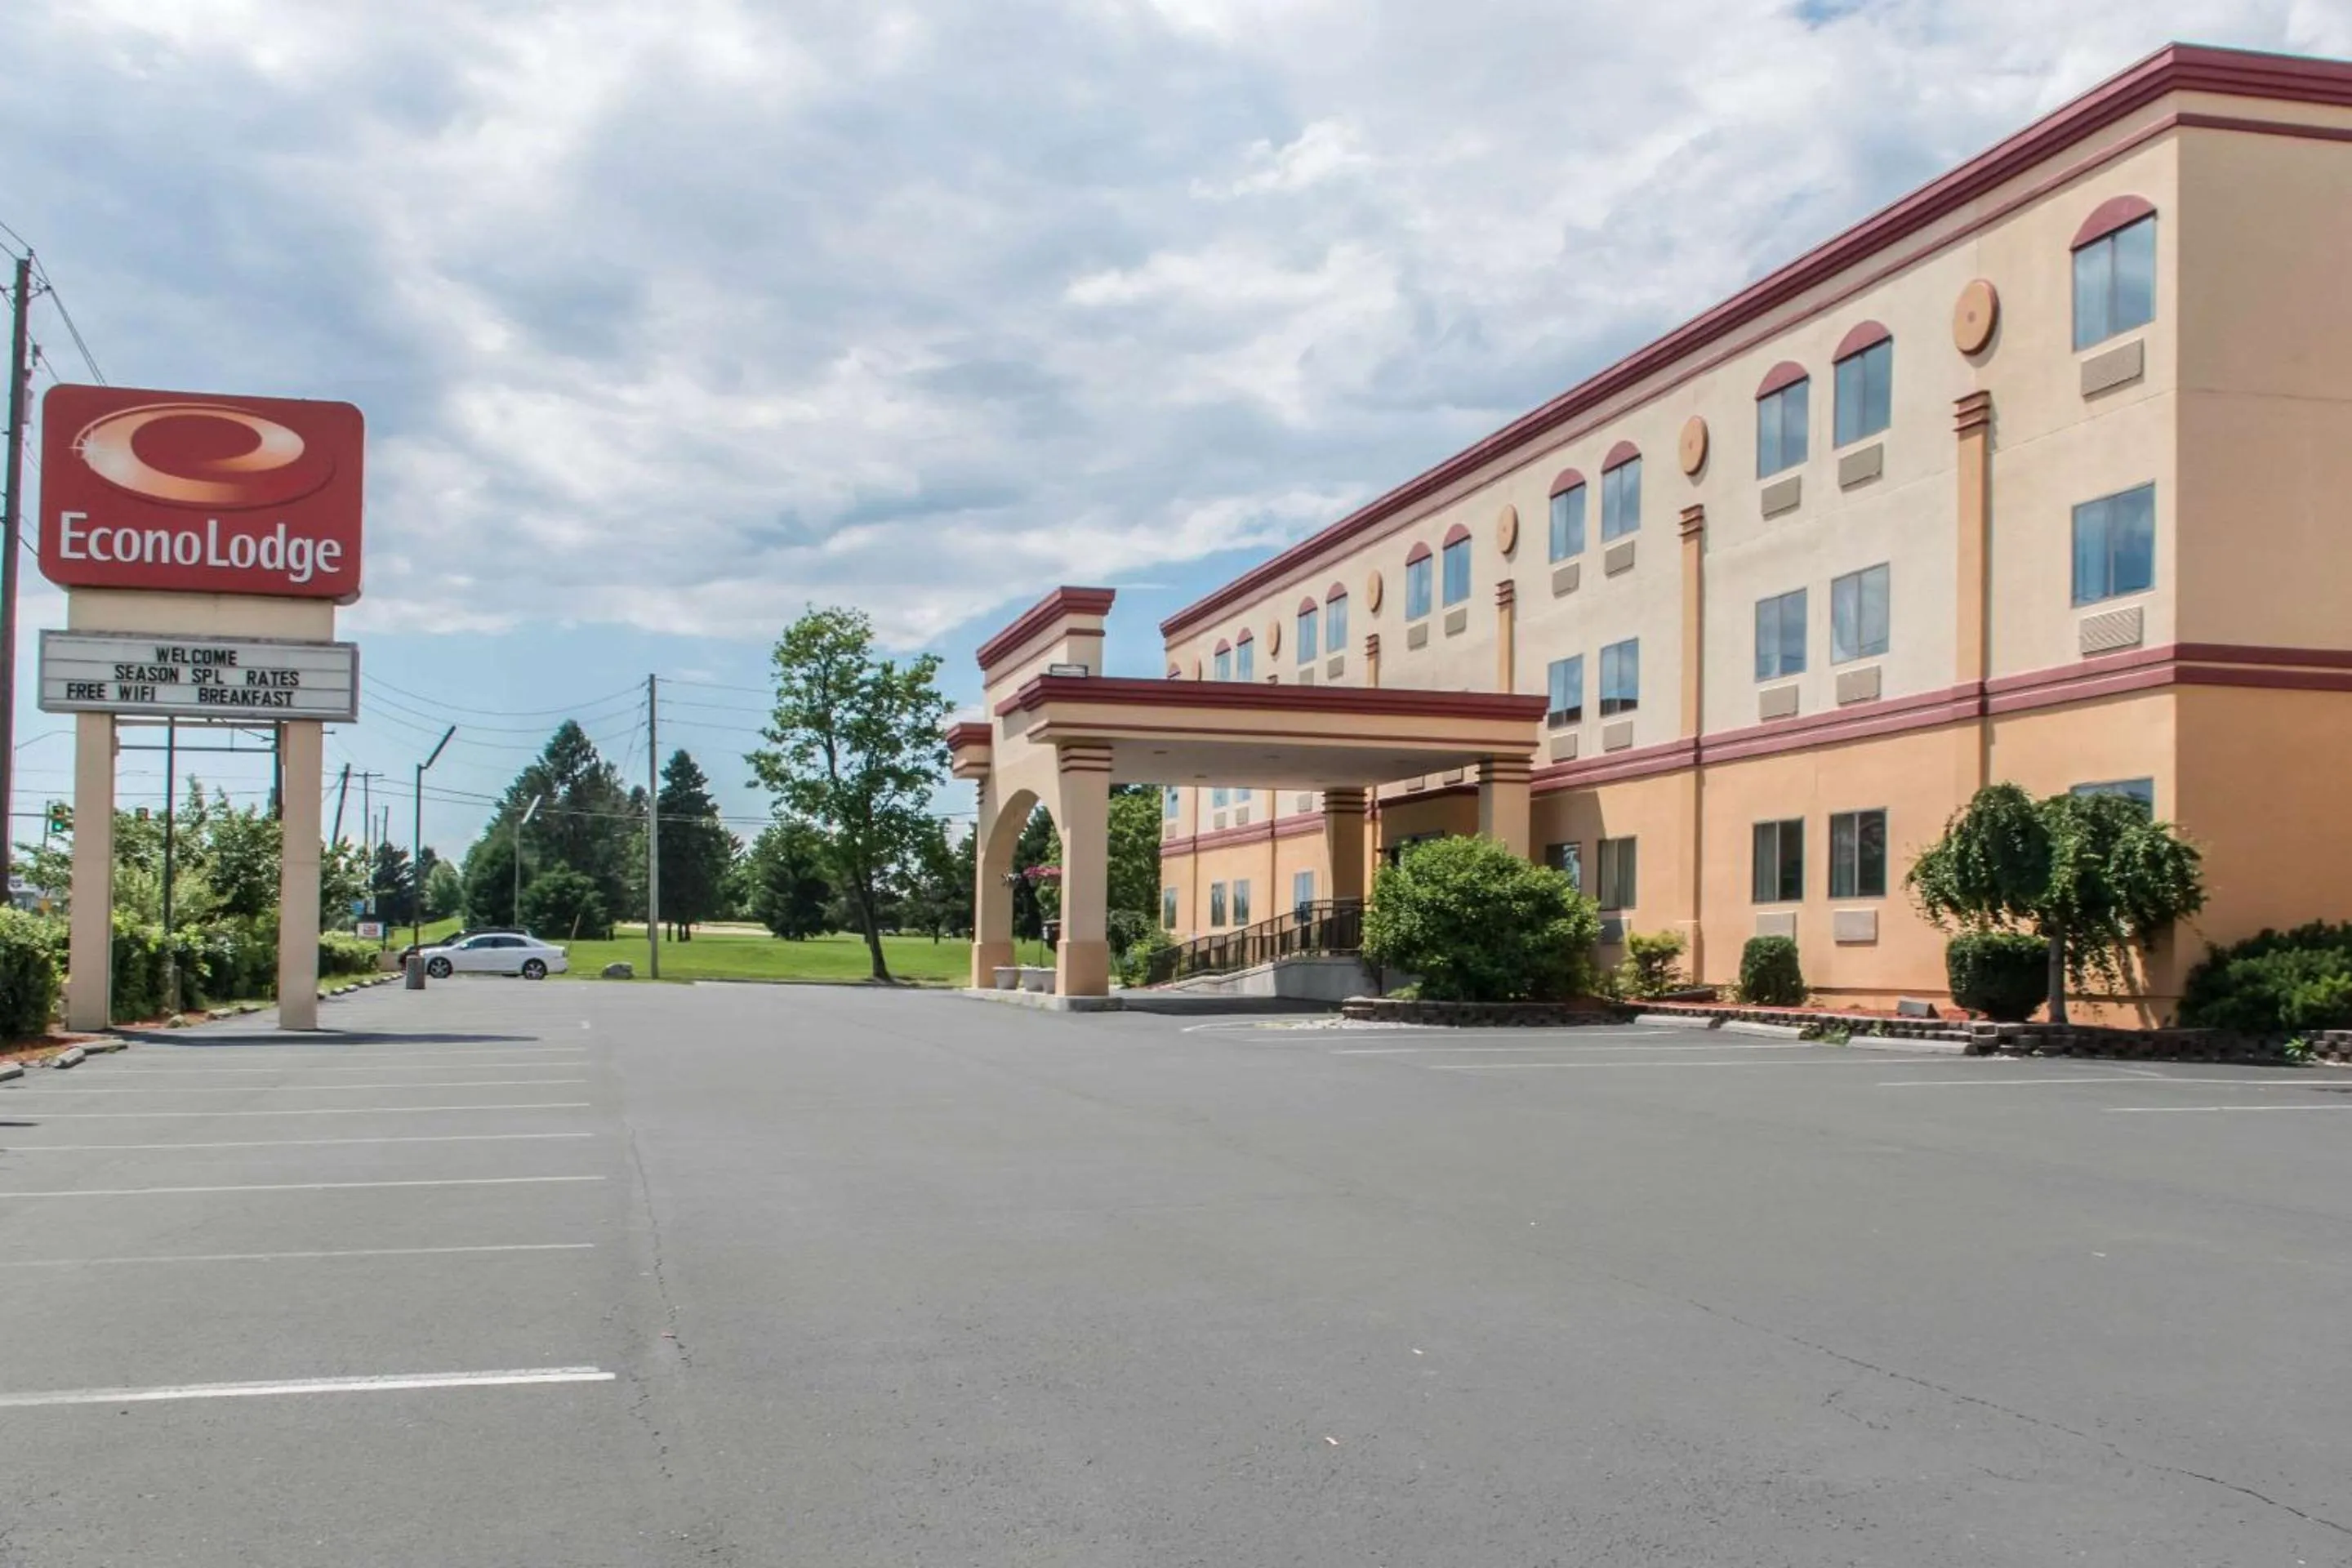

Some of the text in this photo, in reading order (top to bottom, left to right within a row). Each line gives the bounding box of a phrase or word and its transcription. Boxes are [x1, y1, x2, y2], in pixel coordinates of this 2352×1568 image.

[155, 647, 238, 666] WELCOME
[114, 664, 300, 687] SEASON SPL RATES
[66, 682, 294, 707] FREE WIFI BREAKFAST
